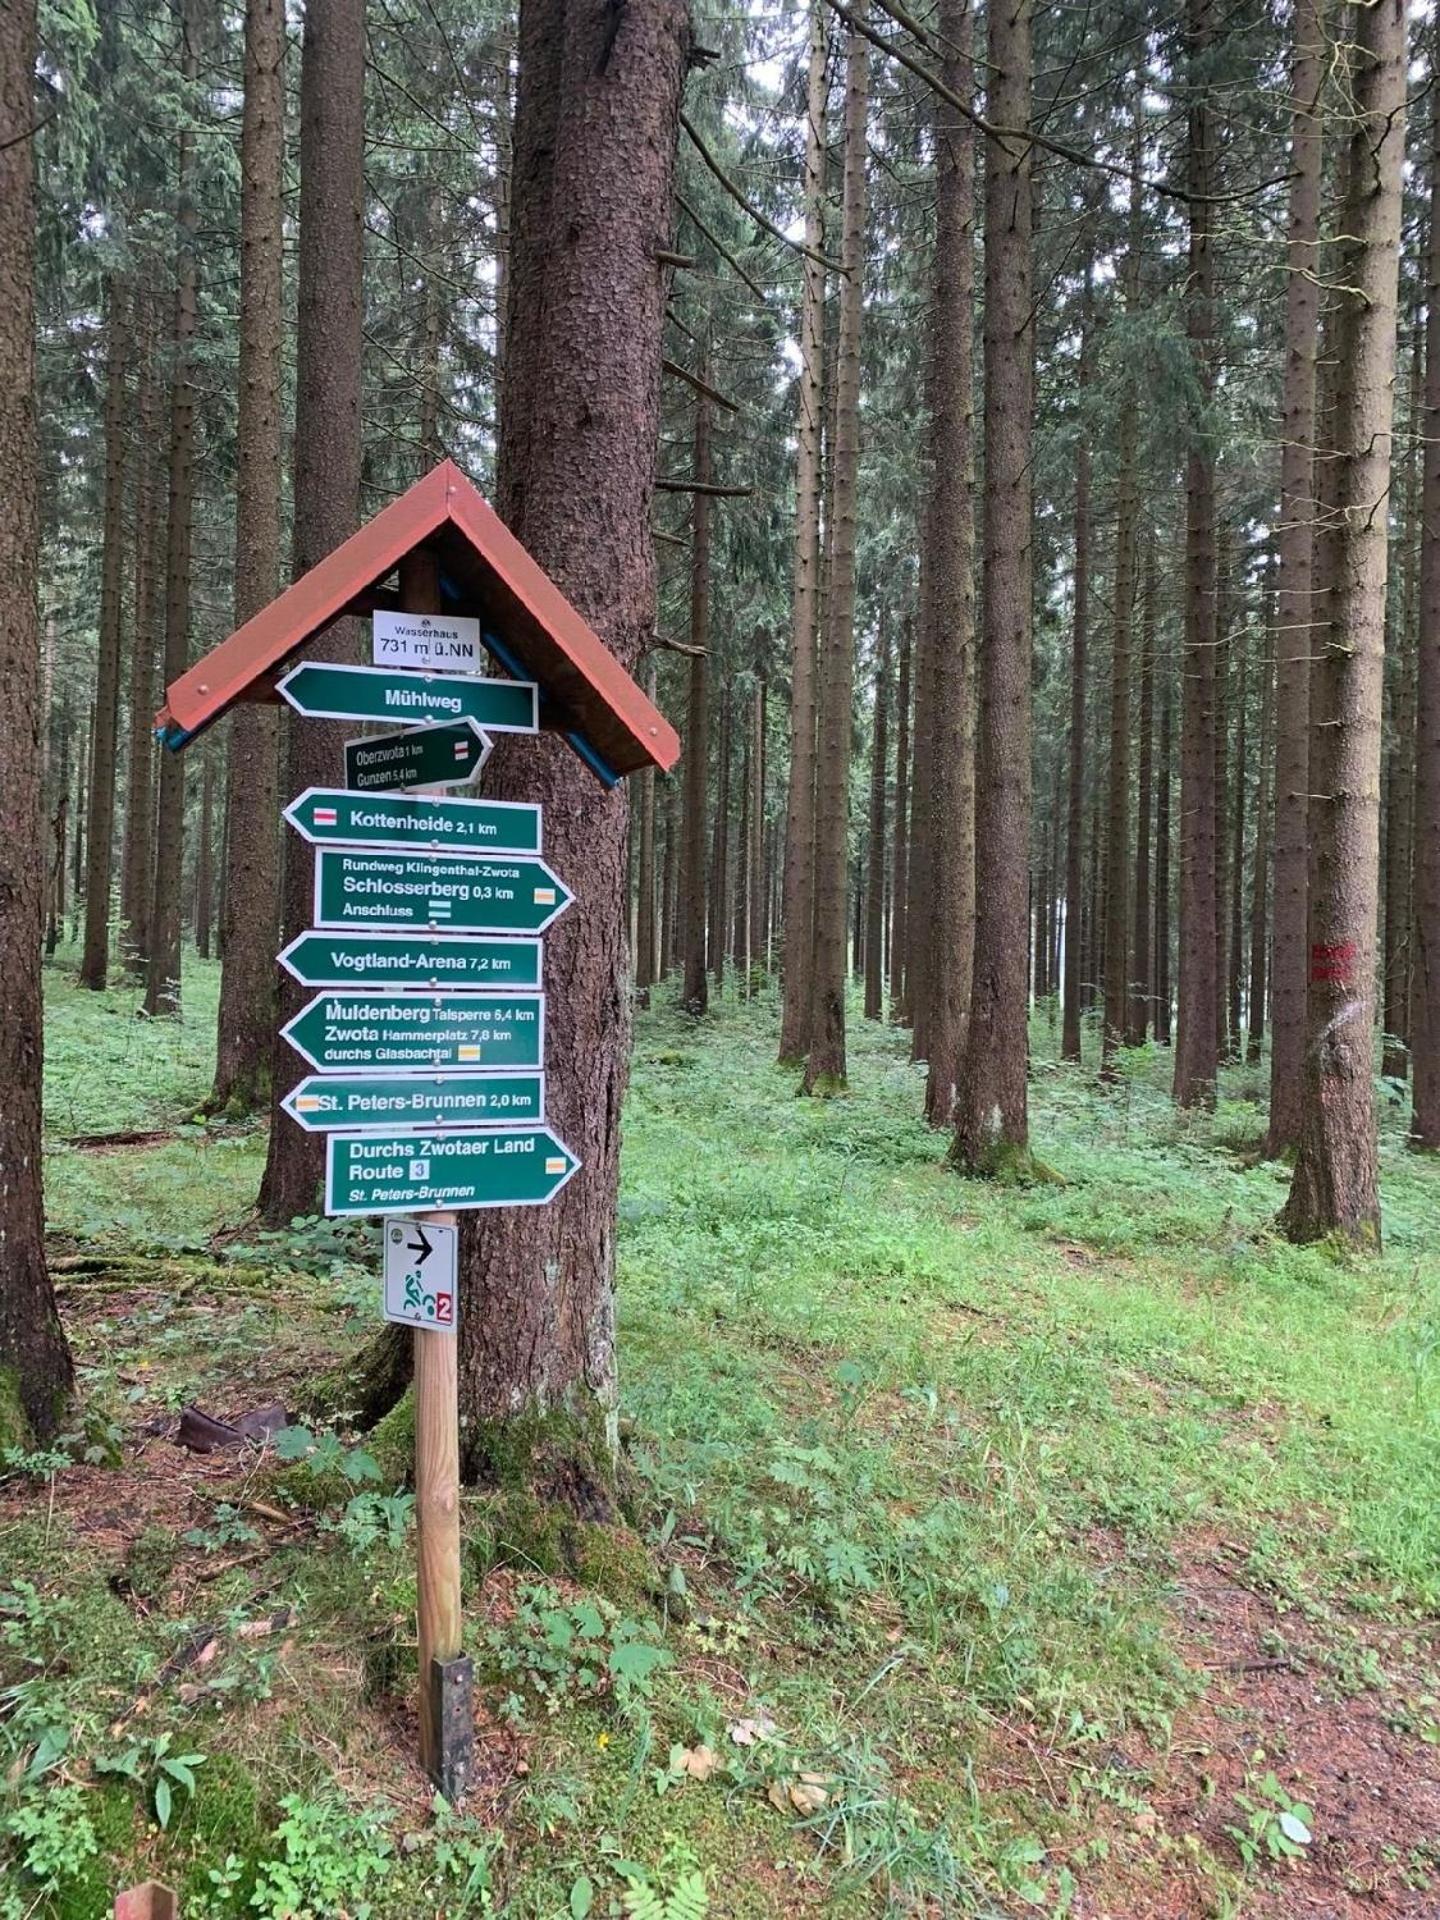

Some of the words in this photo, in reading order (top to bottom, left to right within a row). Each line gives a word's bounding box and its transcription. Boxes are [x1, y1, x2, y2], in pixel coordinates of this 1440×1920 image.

[395, 626, 458, 639] Wasserhaus
[381, 638, 407, 652] 731
[415, 644, 428, 654] m
[435, 643, 473, 657] ü.NN
[385, 690, 462, 713] Mühlweg
[356, 747, 404, 766] Oberzwota
[405, 748, 410, 756] 1
[412, 745, 423, 754] km
[357, 771, 392, 786] Gunzen
[393, 770, 404, 782] 5,4
[405, 768, 417, 778] km
[350, 811, 454, 832] Kottenheide
[457, 822, 474, 836] 2,1
[478, 823, 497, 835] km
[343, 859, 403, 875] Rundweg
[407, 863, 520, 878] Klingenthal-Zwota
[343, 877, 469, 900] Schlosserberg
[473, 887, 492, 899] 0,3
[495, 888, 514, 899] km
[343, 903, 413, 917] Anschluss
[331, 952, 466, 971] Vogtland-Arena
[469, 958, 488, 971] 7,2
[492, 958, 511, 969] km
[326, 1004, 430, 1023] Muldenberg
[433, 1009, 490, 1022] Talsperre
[515, 1009, 534, 1020] km
[325, 1026, 378, 1041] Zwota
[382, 1030, 468, 1043] Hammerplatz
[493, 1030, 511, 1041] km
[325, 1049, 371, 1060] durchs
[375, 1048, 452, 1060] Glasbachtal
[318, 1096, 342, 1111] St.
[348, 1094, 486, 1110] Peters-Brunnen
[490, 1095, 509, 1108] 2,0
[513, 1095, 531, 1106] km
[350, 1143, 414, 1158] Durchs
[420, 1141, 489, 1155] Zwotaer
[495, 1138, 534, 1153] Land
[349, 1164, 404, 1180] Route
[415, 1163, 425, 1177] 3
[349, 1190, 367, 1202] St.
[371, 1186, 475, 1201] Peters-Brunnen
[439, 1298, 450, 1319] 2
